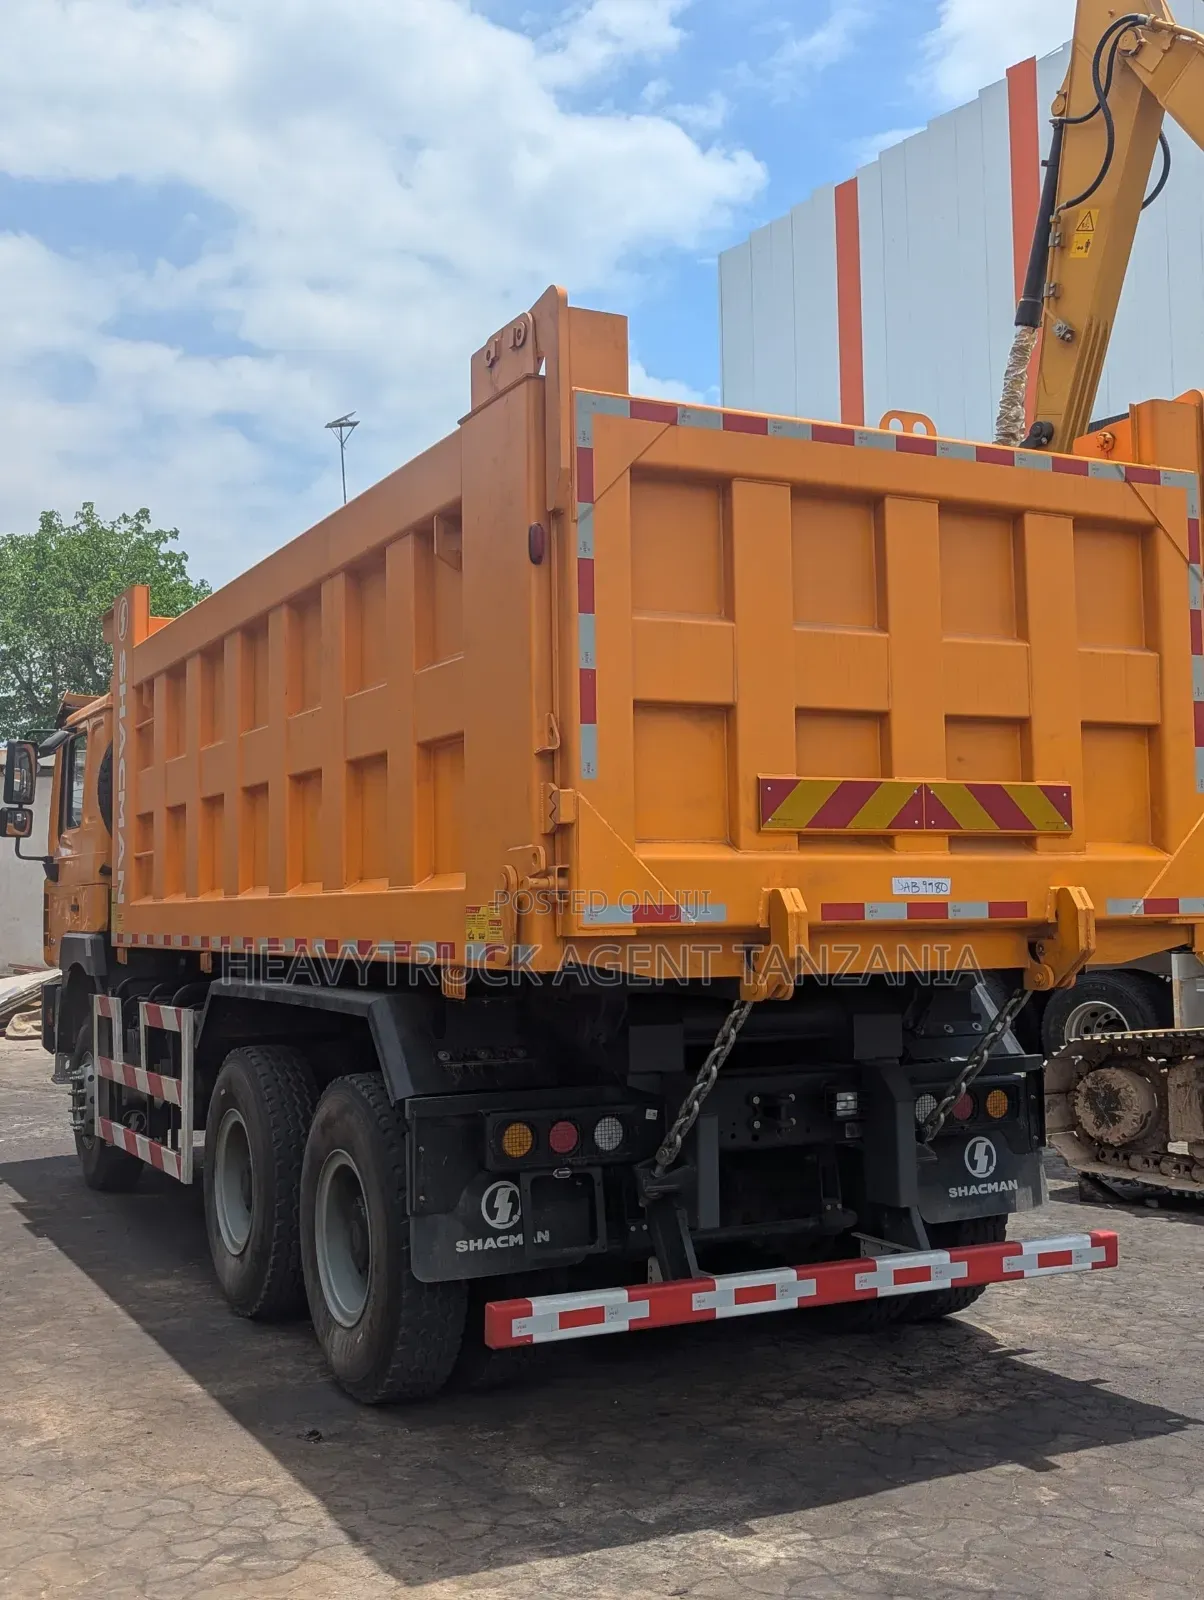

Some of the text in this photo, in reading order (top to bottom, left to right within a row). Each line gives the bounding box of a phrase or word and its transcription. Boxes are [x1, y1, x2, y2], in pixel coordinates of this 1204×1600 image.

[117, 648, 127, 904] SHACMAN
[948, 1179, 1019, 1198] SHACMAN
[455, 1230, 550, 1253] SHACMN
